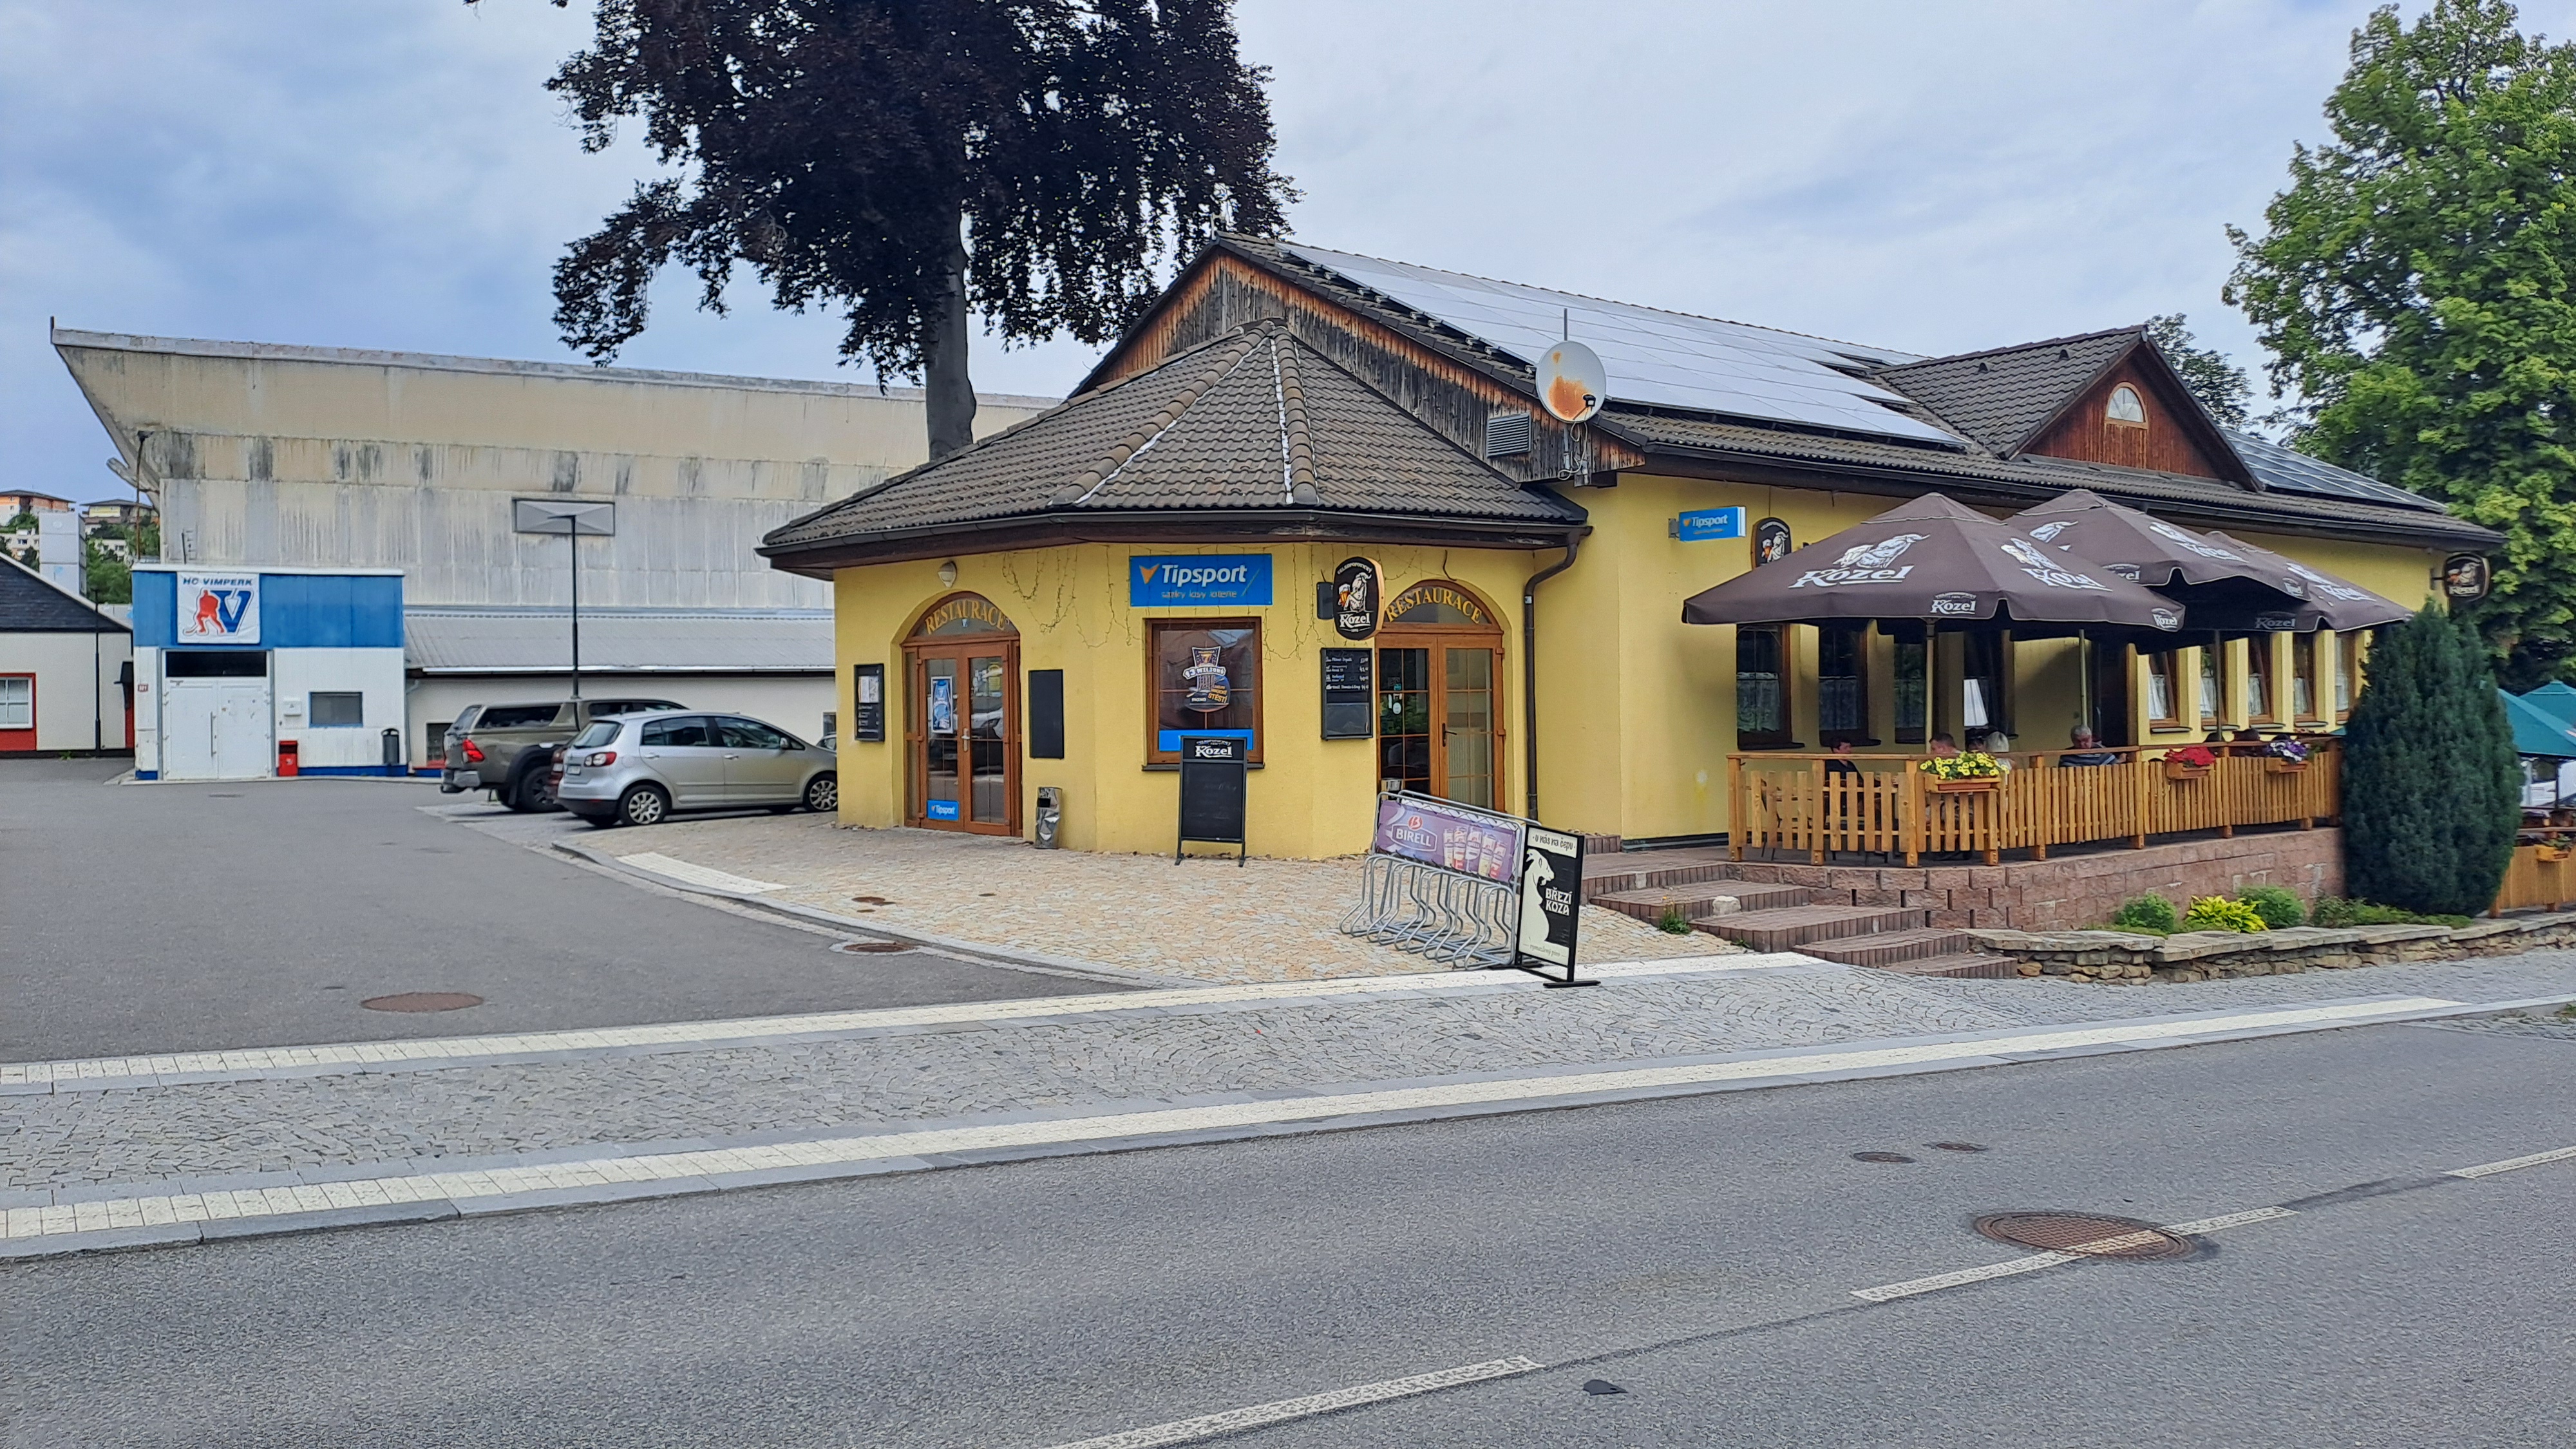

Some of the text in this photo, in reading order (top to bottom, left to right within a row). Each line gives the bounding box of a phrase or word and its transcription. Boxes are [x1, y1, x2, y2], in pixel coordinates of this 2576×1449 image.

[1692, 515, 1728, 528] Tipsport
[203, 578, 252, 586] VIMPERK
[1162, 565, 1247, 587] Tipsport
[1788, 565, 1915, 589] Kozel
[1386, 587, 1481, 624] RESTAURACE
[1930, 600, 1976, 614] Kozel
[925, 599, 1005, 635] RESTAURACE
[1340, 613, 1371, 629] Kozel
[2153, 613, 2177, 629] Kozel
[2255, 617, 2296, 630] Kozel
[1185, 668, 1196, 677] 13
[1195, 746, 1233, 758] Kozel
[936, 804, 955, 815] Tipsport
[1396, 828, 1432, 847] BIRELL
[1540, 834, 1550, 845] nás
[1551, 838, 1558, 847] na
[1560, 837, 1573, 851] čepu
[1546, 886, 1573, 905] BŘEZÍ
[1546, 900, 1569, 916] KOZA
